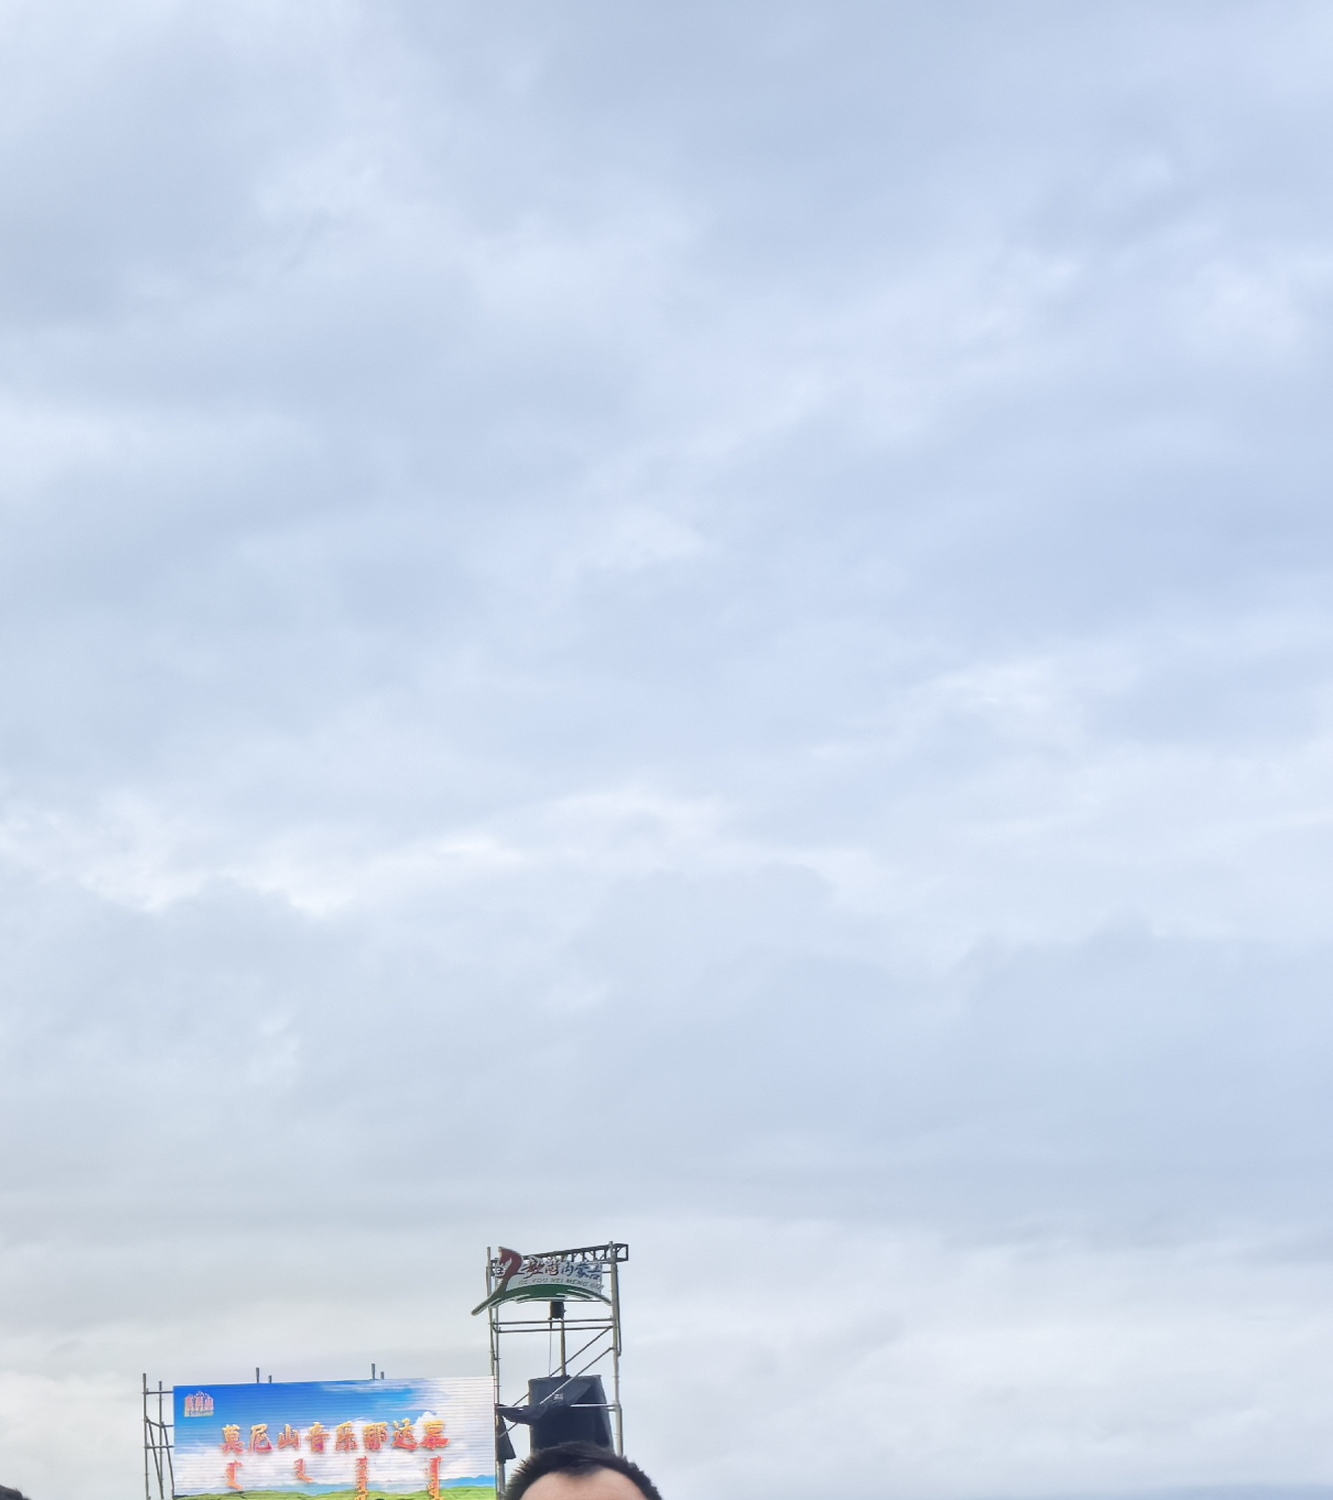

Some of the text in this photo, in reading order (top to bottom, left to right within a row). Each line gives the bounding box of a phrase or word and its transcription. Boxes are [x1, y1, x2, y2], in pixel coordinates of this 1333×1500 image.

[220, 1418, 451, 1453] 莫尼山音乐那达慕
